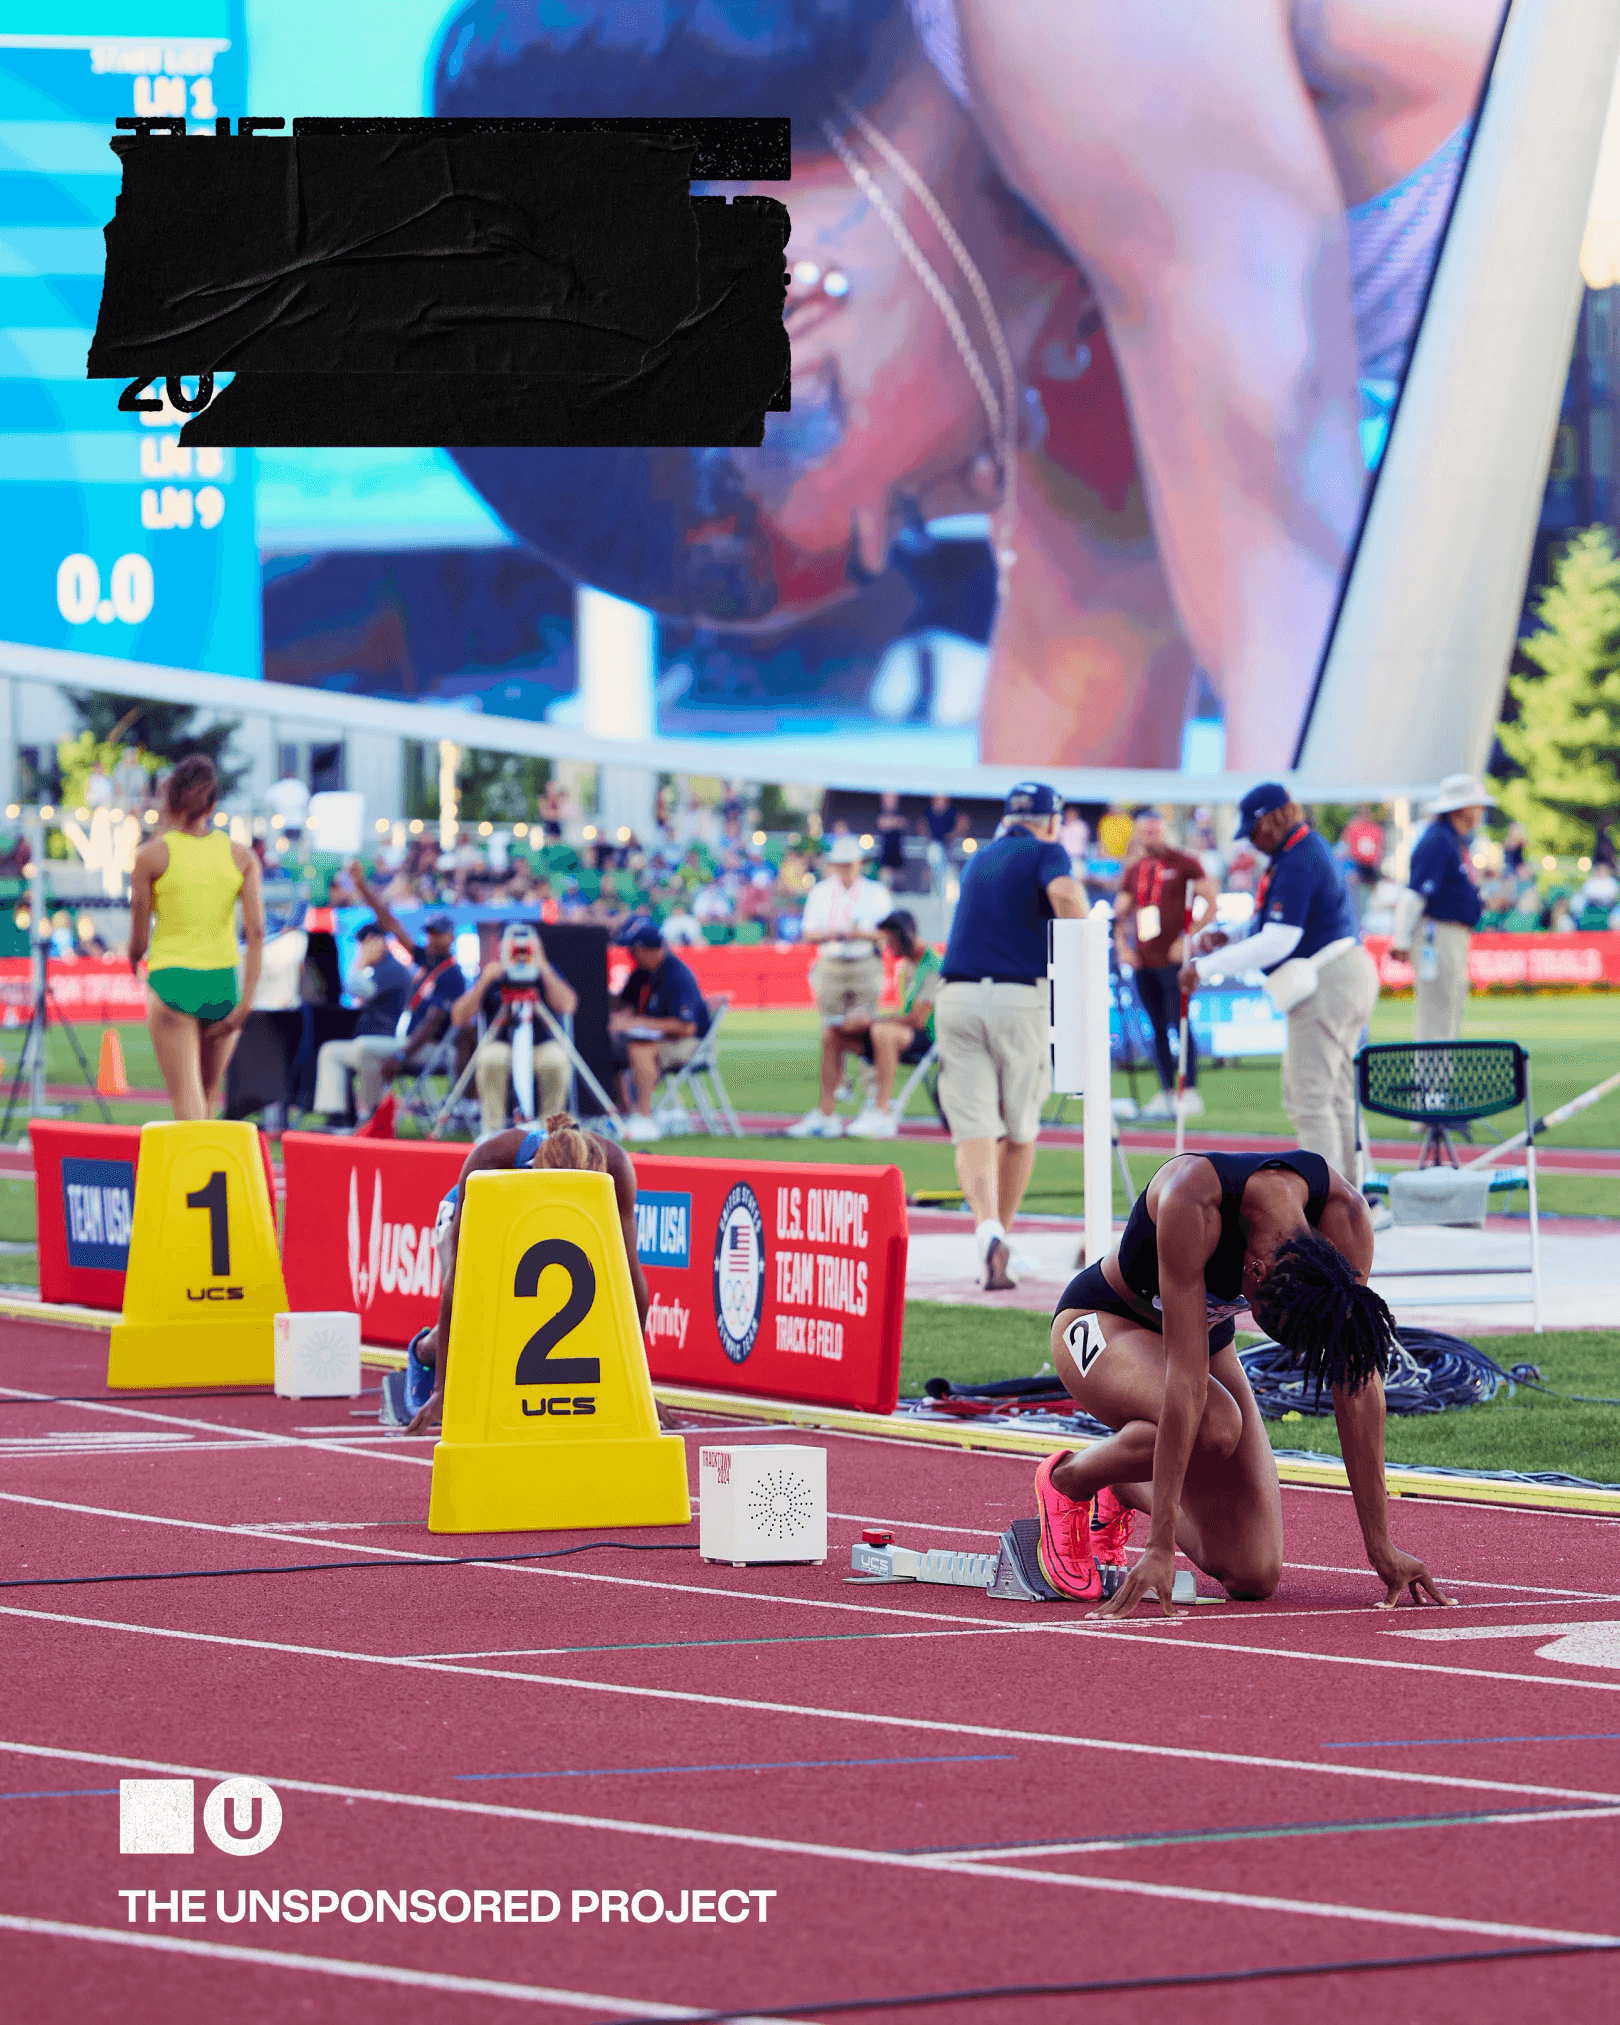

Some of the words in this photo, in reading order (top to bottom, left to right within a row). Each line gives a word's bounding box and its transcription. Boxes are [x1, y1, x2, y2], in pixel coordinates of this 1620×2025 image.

[190, 76, 218, 119] 1
[195, 486, 225, 529] 9
[57, 553, 154, 625] 0.0
[67, 1184, 105, 1244] TEAM
[187, 1171, 230, 1276] 1
[660, 1206, 687, 1254] USA
[776, 1186, 804, 1240] U.S.
[807, 1188, 869, 1249] OLYMPIC
[187, 1287, 244, 1301] UCS
[775, 1250, 814, 1306] TEAM
[816, 1254, 868, 1317] TRIALS
[514, 1238, 600, 1385] 2
[775, 1314, 808, 1355] TRACK
[816, 1319, 844, 1361] FIELD
[1069, 1320, 1099, 1371] 2
[521, 1396, 597, 1416] UCS
[860, 1554, 889, 1571] UCS
